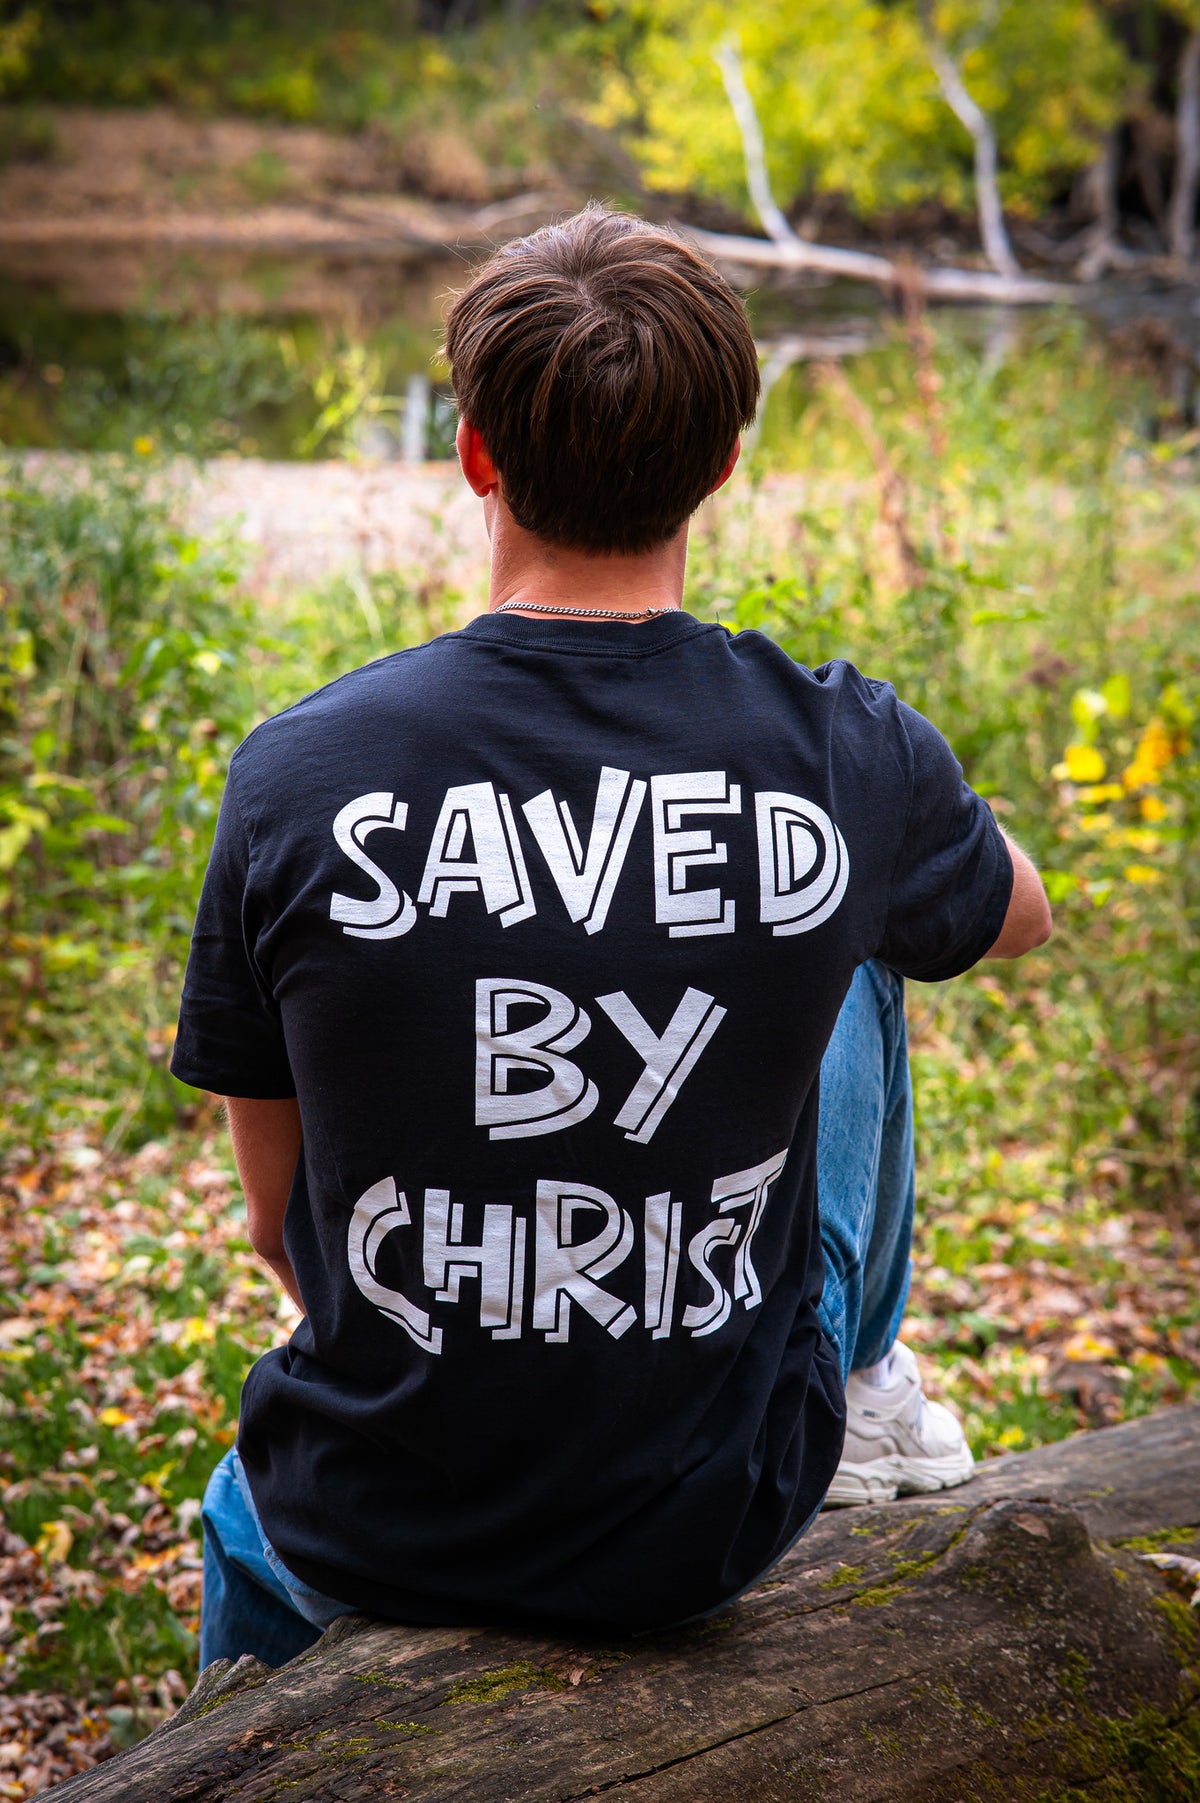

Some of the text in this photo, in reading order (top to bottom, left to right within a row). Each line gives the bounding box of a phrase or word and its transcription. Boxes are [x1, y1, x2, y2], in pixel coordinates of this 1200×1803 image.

[330, 766, 849, 939] SAVED
[475, 978, 727, 1144] BY
[348, 1148, 788, 1354] CHRIST
